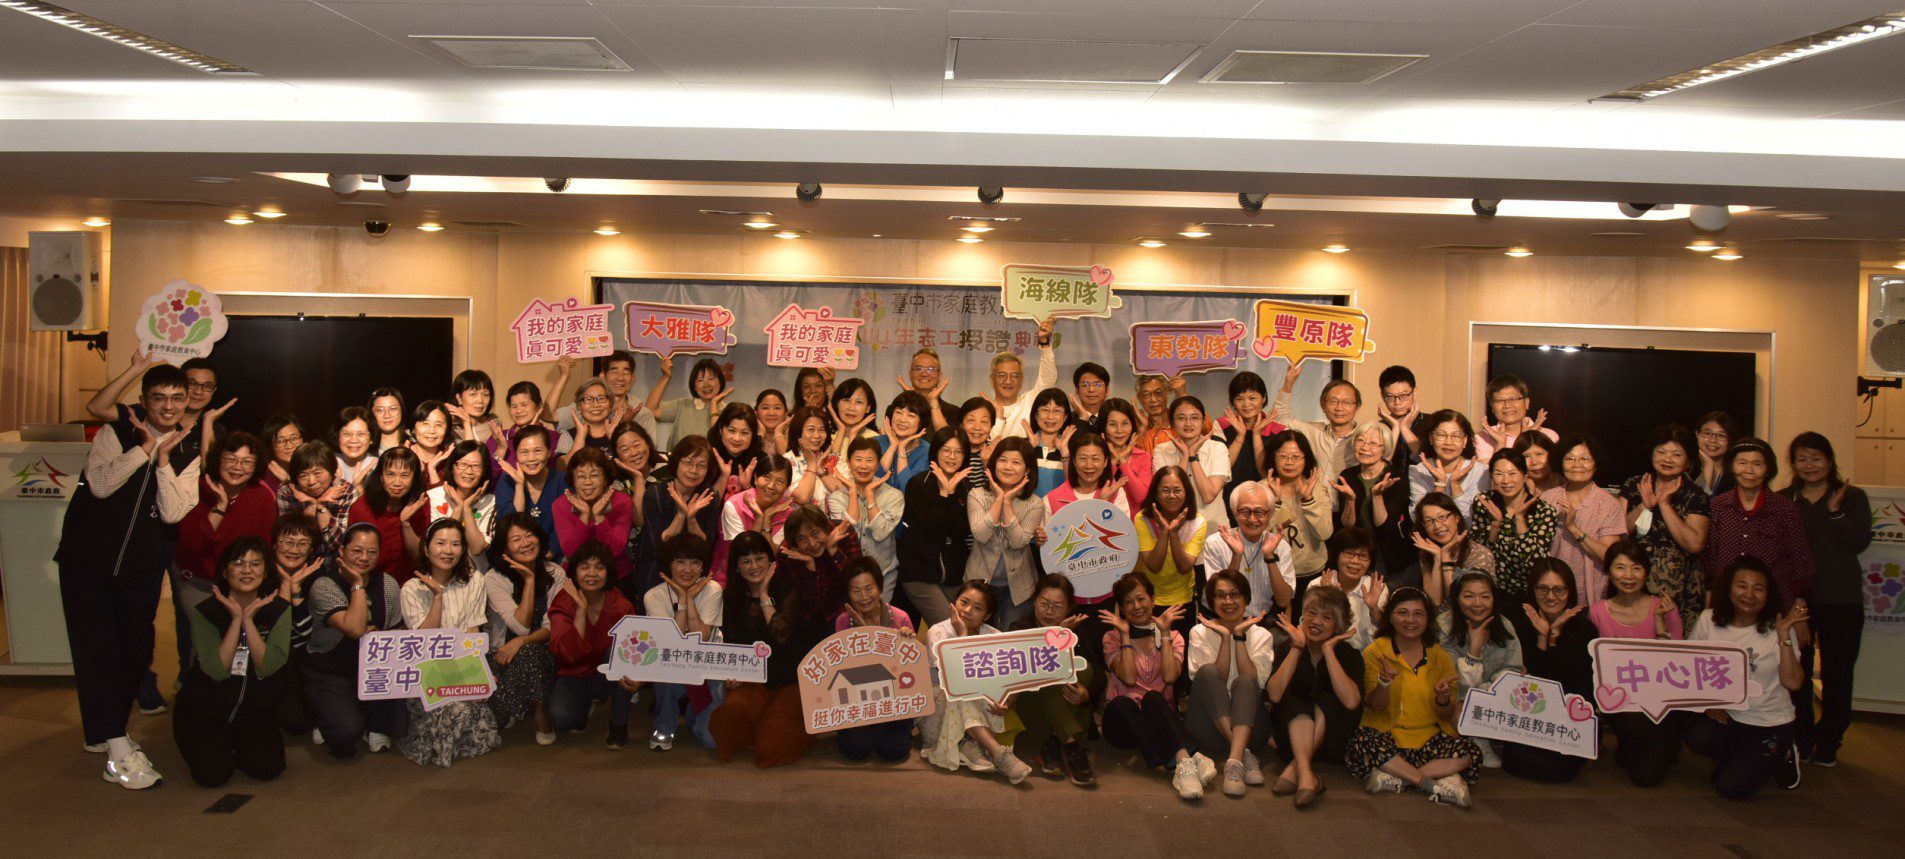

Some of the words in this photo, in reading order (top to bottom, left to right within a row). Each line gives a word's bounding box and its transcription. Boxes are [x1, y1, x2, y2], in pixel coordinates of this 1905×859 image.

[892, 292, 1004, 315] 臺中市家庭教
[1018, 276, 1099, 305] 海線隊
[527, 313, 604, 336] 我的家庭
[640, 315, 716, 343] 大雅隊
[780, 323, 853, 343] 我的家庭
[1272, 313, 1355, 348] 豐原隊
[1148, 334, 1229, 360] 東勢隊
[1067, 553, 1119, 571] 臺中市政府
[367, 634, 455, 662] 好家在
[660, 648, 760, 667] 臺中市家庭教育中心
[804, 632, 919, 683] 好家在臺中
[962, 645, 1062, 679] 諮詢隊
[363, 666, 420, 694] 臺中
[1616, 656, 1733, 693] 中心隊
[440, 685, 486, 696] TAICHUNG
[814, 695, 925, 728] 挺你幸福進行中
[1471, 705, 1581, 741] 臺中市家庭教育中心
